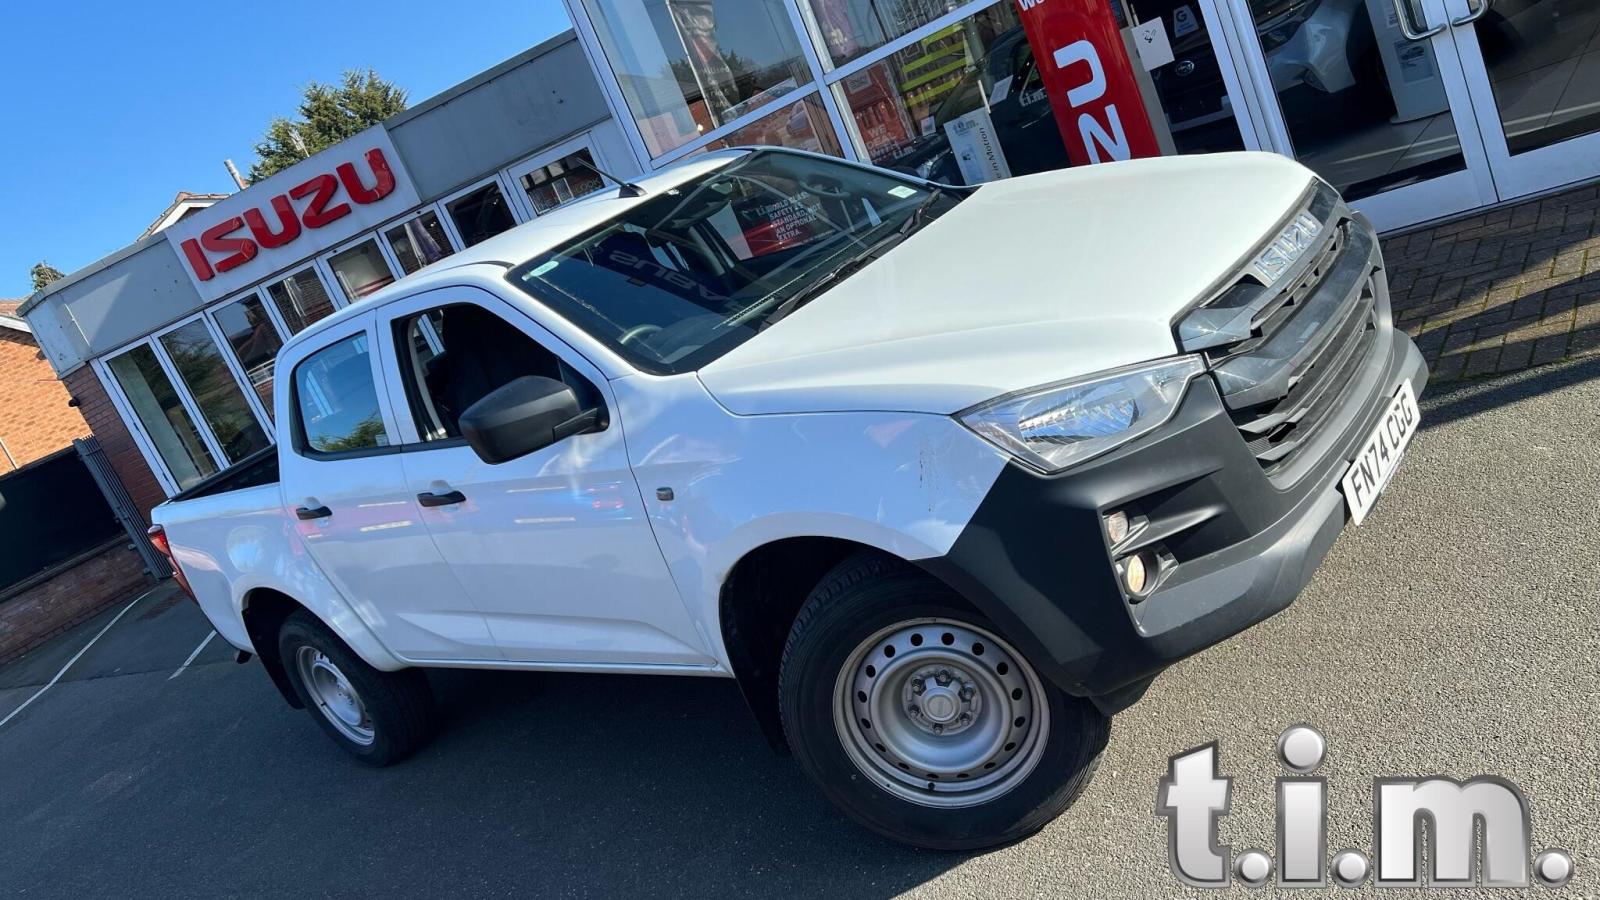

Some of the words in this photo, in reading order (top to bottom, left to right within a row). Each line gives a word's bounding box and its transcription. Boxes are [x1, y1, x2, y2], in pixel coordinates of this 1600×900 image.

[180, 148, 396, 282] ISUZU
[768, 207, 793, 221] SAFETY
[775, 224, 787, 236] AN
[785, 215, 817, 231] OPTIONAL
[1254, 213, 1319, 281] ISUZU
[1351, 430, 1390, 508] FN74
[1386, 392, 1413, 450] CGG
